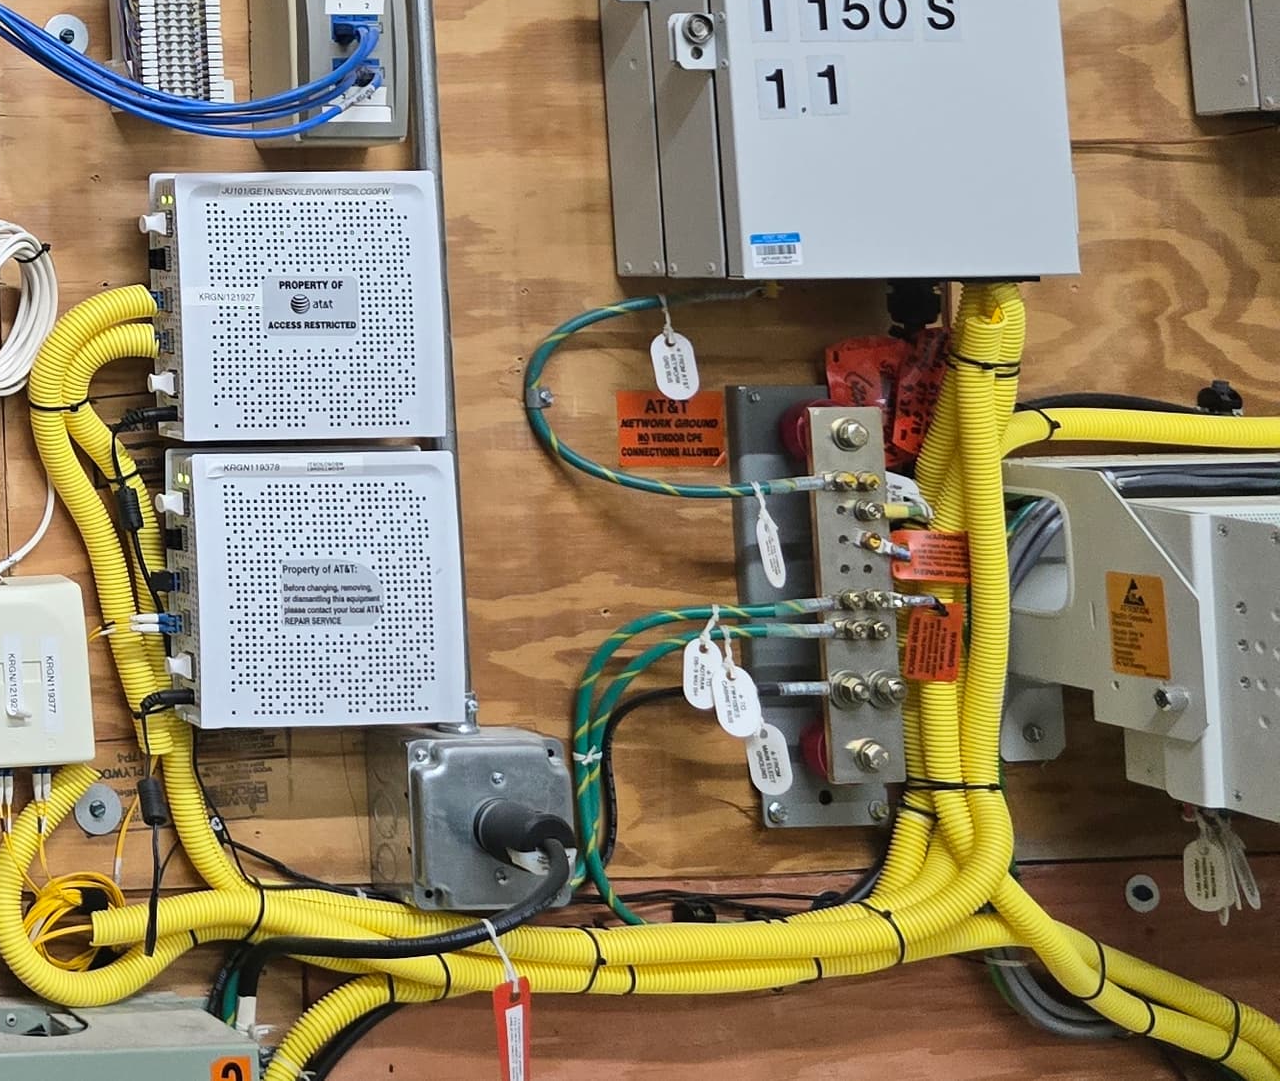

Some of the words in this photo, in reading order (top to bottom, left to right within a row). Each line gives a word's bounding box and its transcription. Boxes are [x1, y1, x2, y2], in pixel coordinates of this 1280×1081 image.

[279, 280, 328, 290] PROPERTY
[331, 280, 344, 289] OF
[199, 292, 256, 302] KRGN/121927
[312, 299, 333, 309] at&t
[268, 321, 302, 329] ACCESS
[304, 321, 357, 329] RESTRICTED
[645, 399, 689, 414] AT&T
[620, 418, 672, 428] NETWORK
[675, 418, 718, 428] GROUND
[637, 433, 649, 444] NO
[651, 433, 684, 443] VENDOR
[687, 433, 703, 443] CPE
[621, 447, 680, 457] CONNECTIONS
[682, 447, 720, 457] ALLOWED
[282, 564, 320, 576] Property
[322, 564, 331, 574] of
[333, 564, 358, 574] AT&T:
[283, 583, 306, 592] Before
[307, 583, 339, 593] changing,
[341, 584, 372, 593] removing,
[292, 595, 331, 604] dismantling
[346, 595, 380, 604] equipment
[284, 607, 306, 615] please
[333, 607, 348, 615] your
[349, 606, 365, 614] local
[284, 616, 310, 625] REPAIR
[311, 616, 342, 625] SERVICE
[46, 655, 57, 714] KRGN119377
